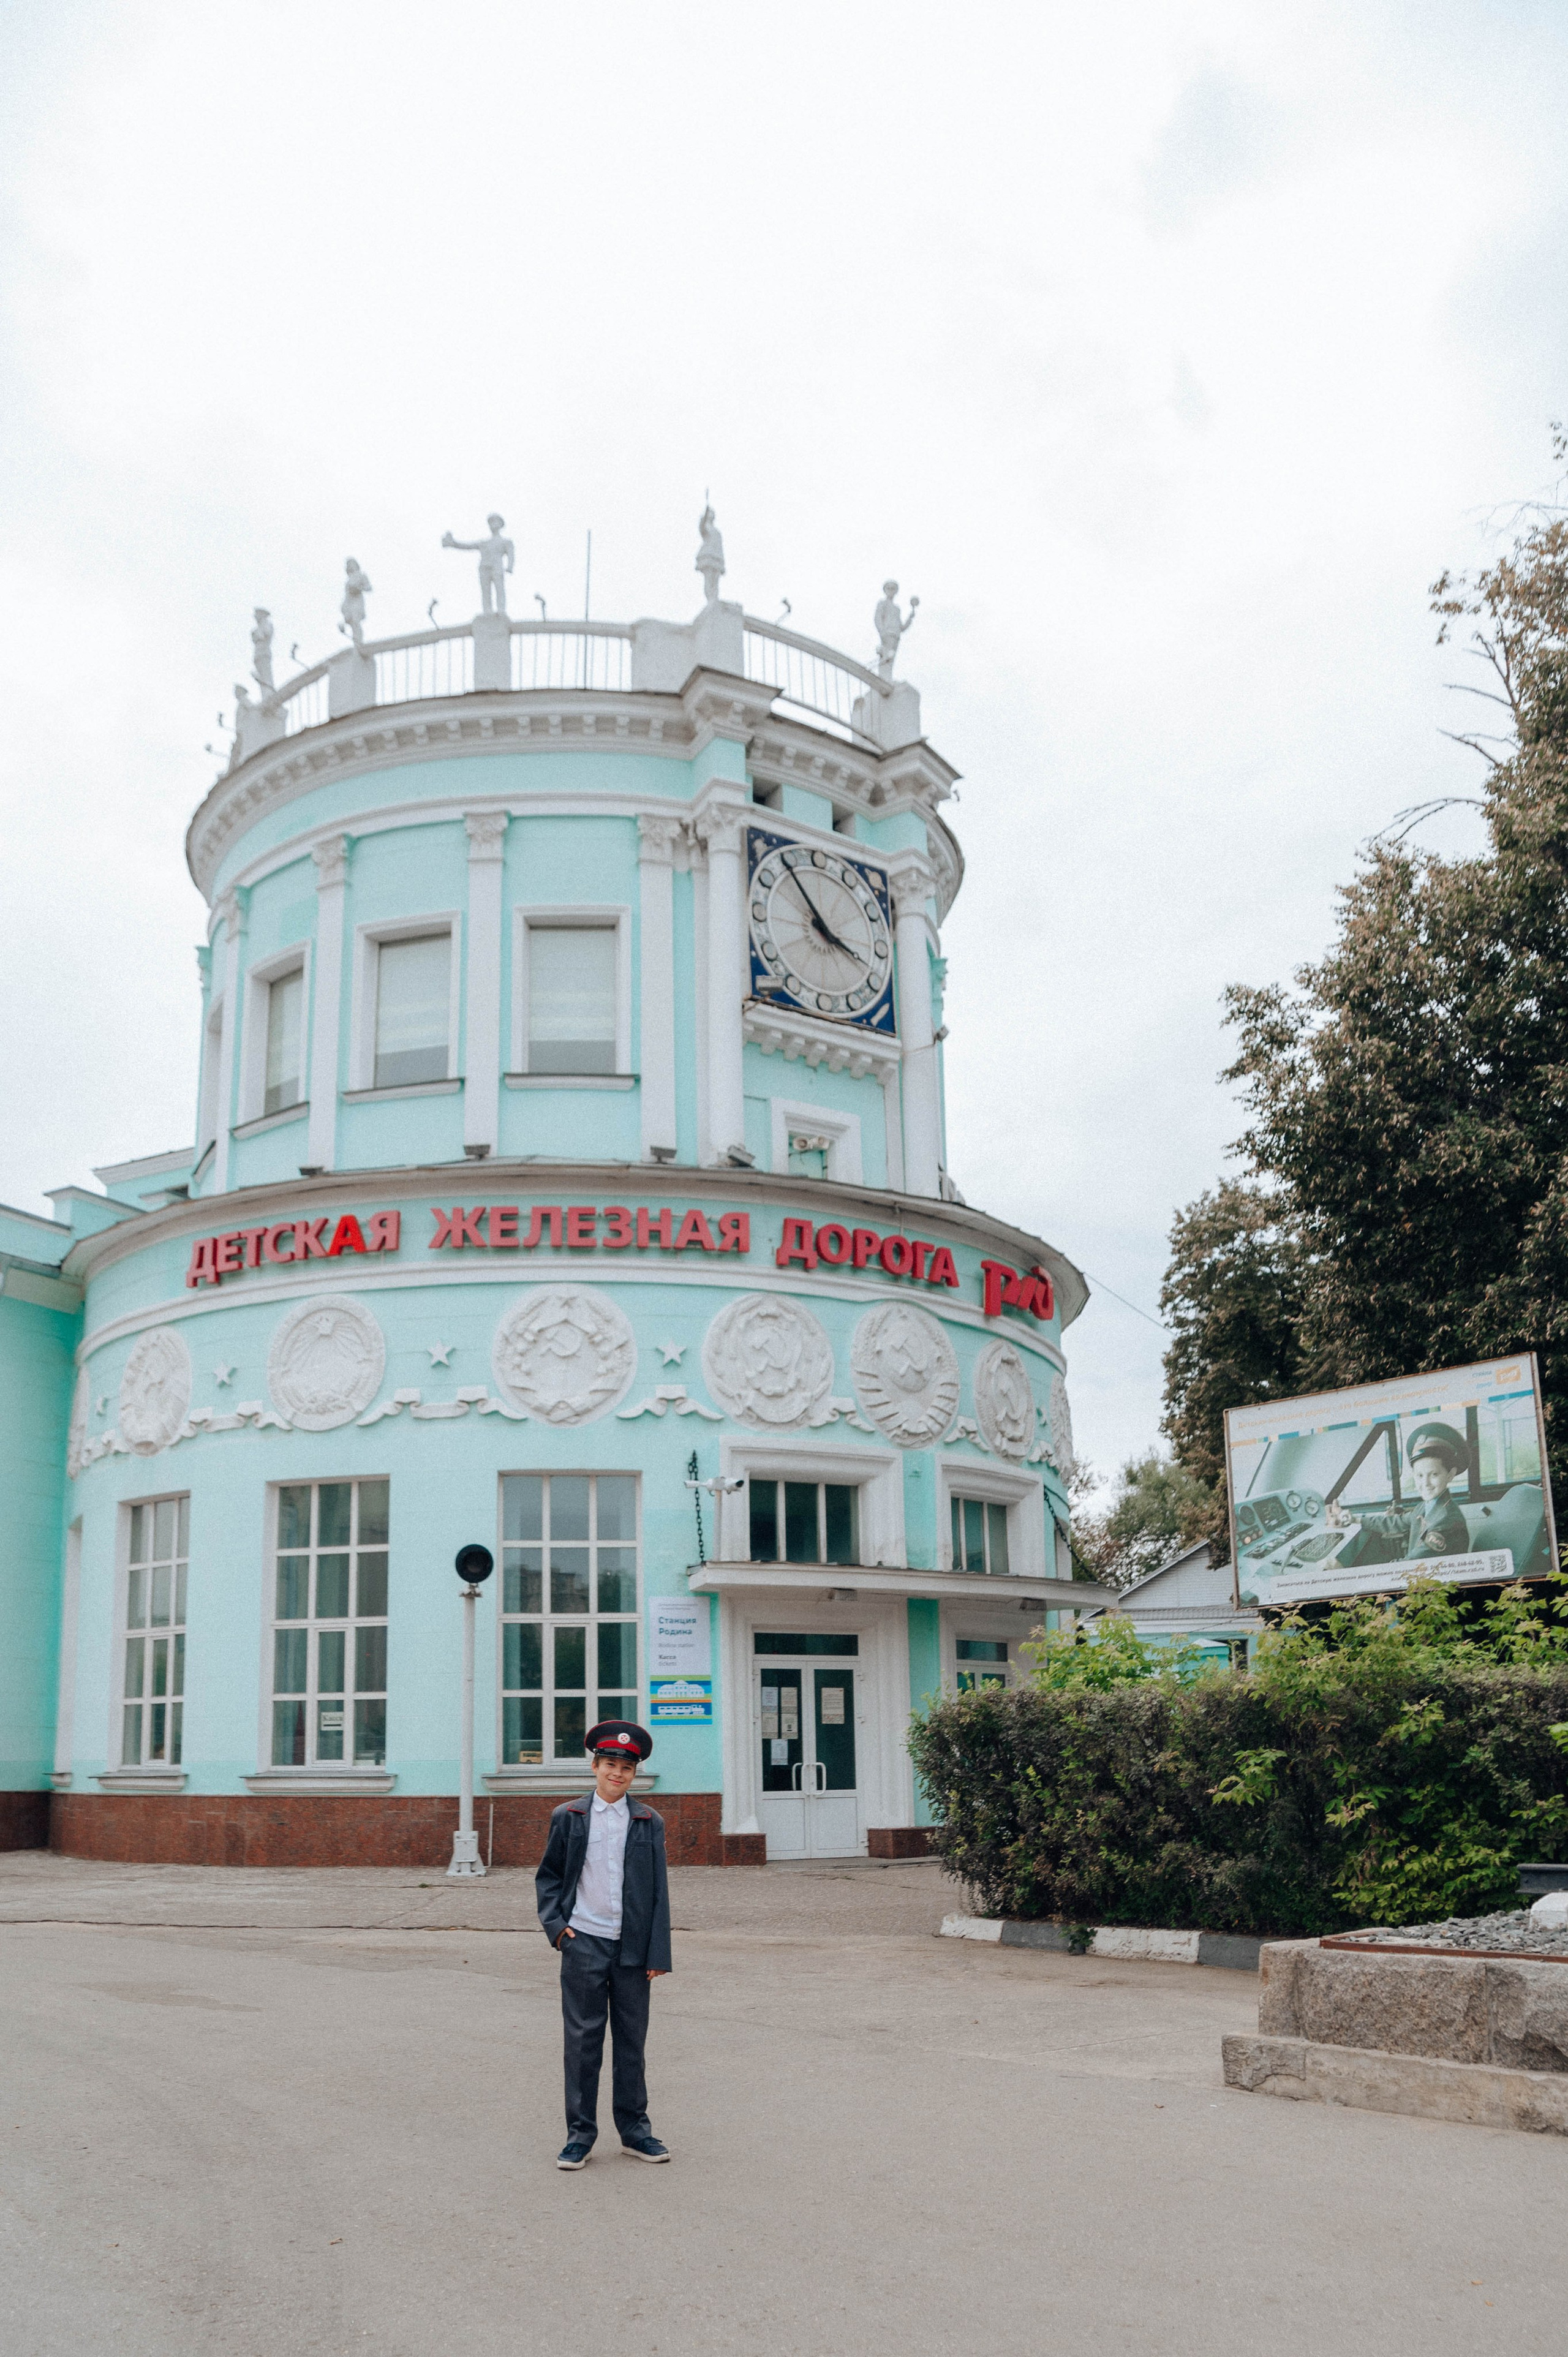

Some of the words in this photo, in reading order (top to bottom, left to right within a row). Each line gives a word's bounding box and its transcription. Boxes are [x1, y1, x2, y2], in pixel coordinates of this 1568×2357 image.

[186, 1209, 401, 1288] ДЕТСКАЯ
[429, 1205, 750, 1253] ЖЕЛЕЗНАЯ
[776, 1216, 960, 1288] ДОРОГА
[658, 1616, 697, 1625] Станция
[658, 1627, 693, 1636] Родина
